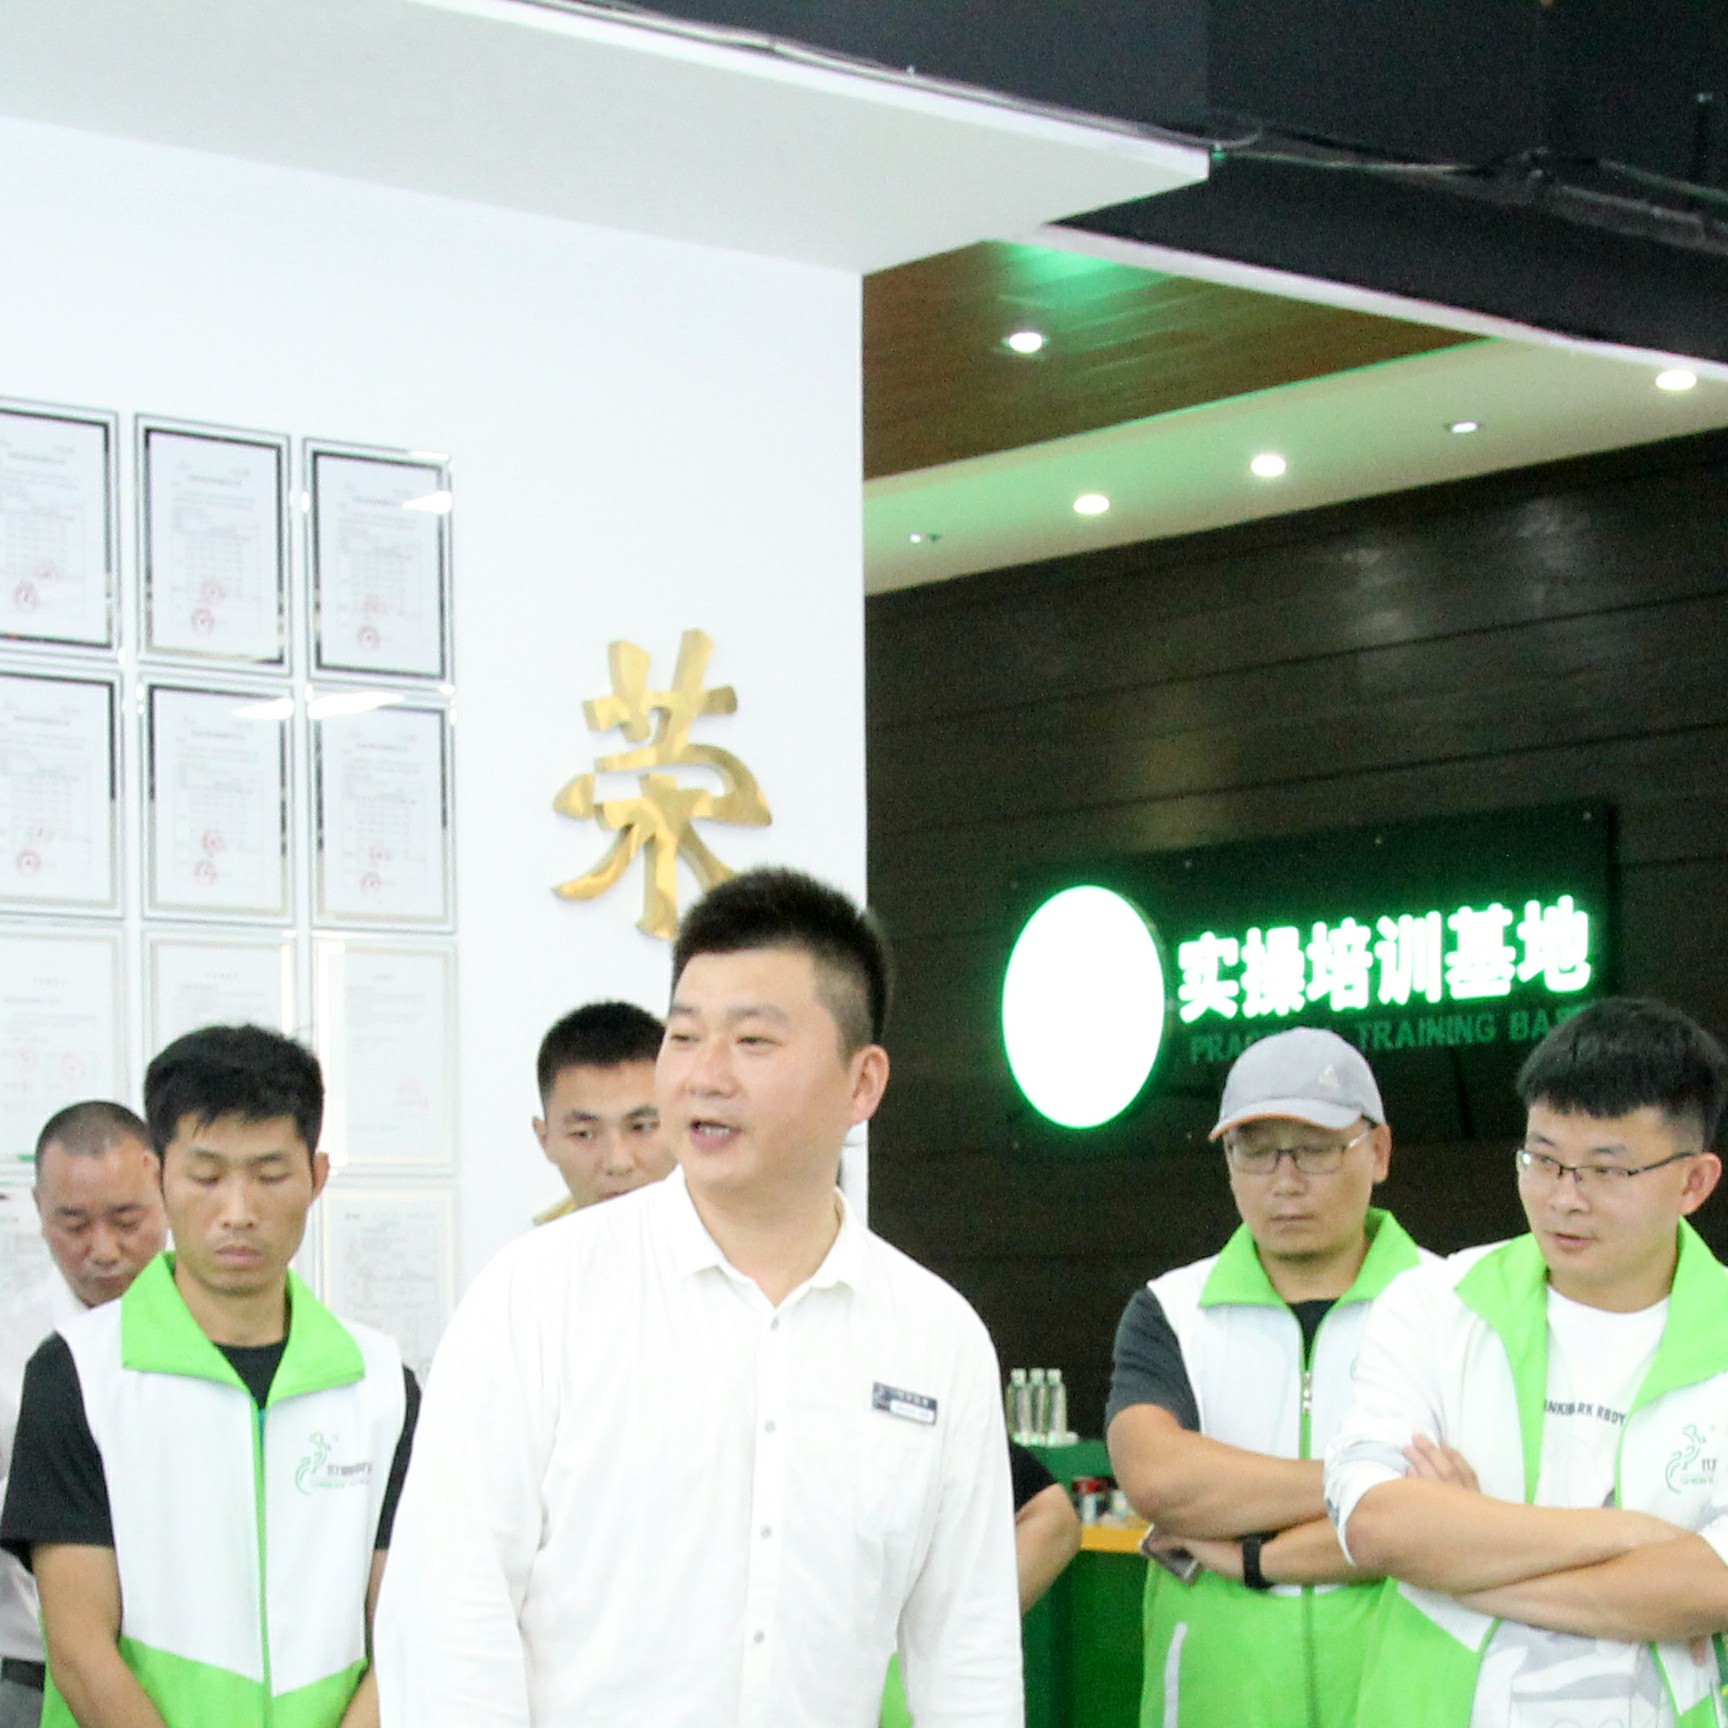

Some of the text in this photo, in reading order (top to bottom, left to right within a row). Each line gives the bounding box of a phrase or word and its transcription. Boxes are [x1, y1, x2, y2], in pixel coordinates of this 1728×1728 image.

[1177, 894, 1593, 1024] 实操培训基地
[1356, 1012, 1497, 1051] TRAINING
